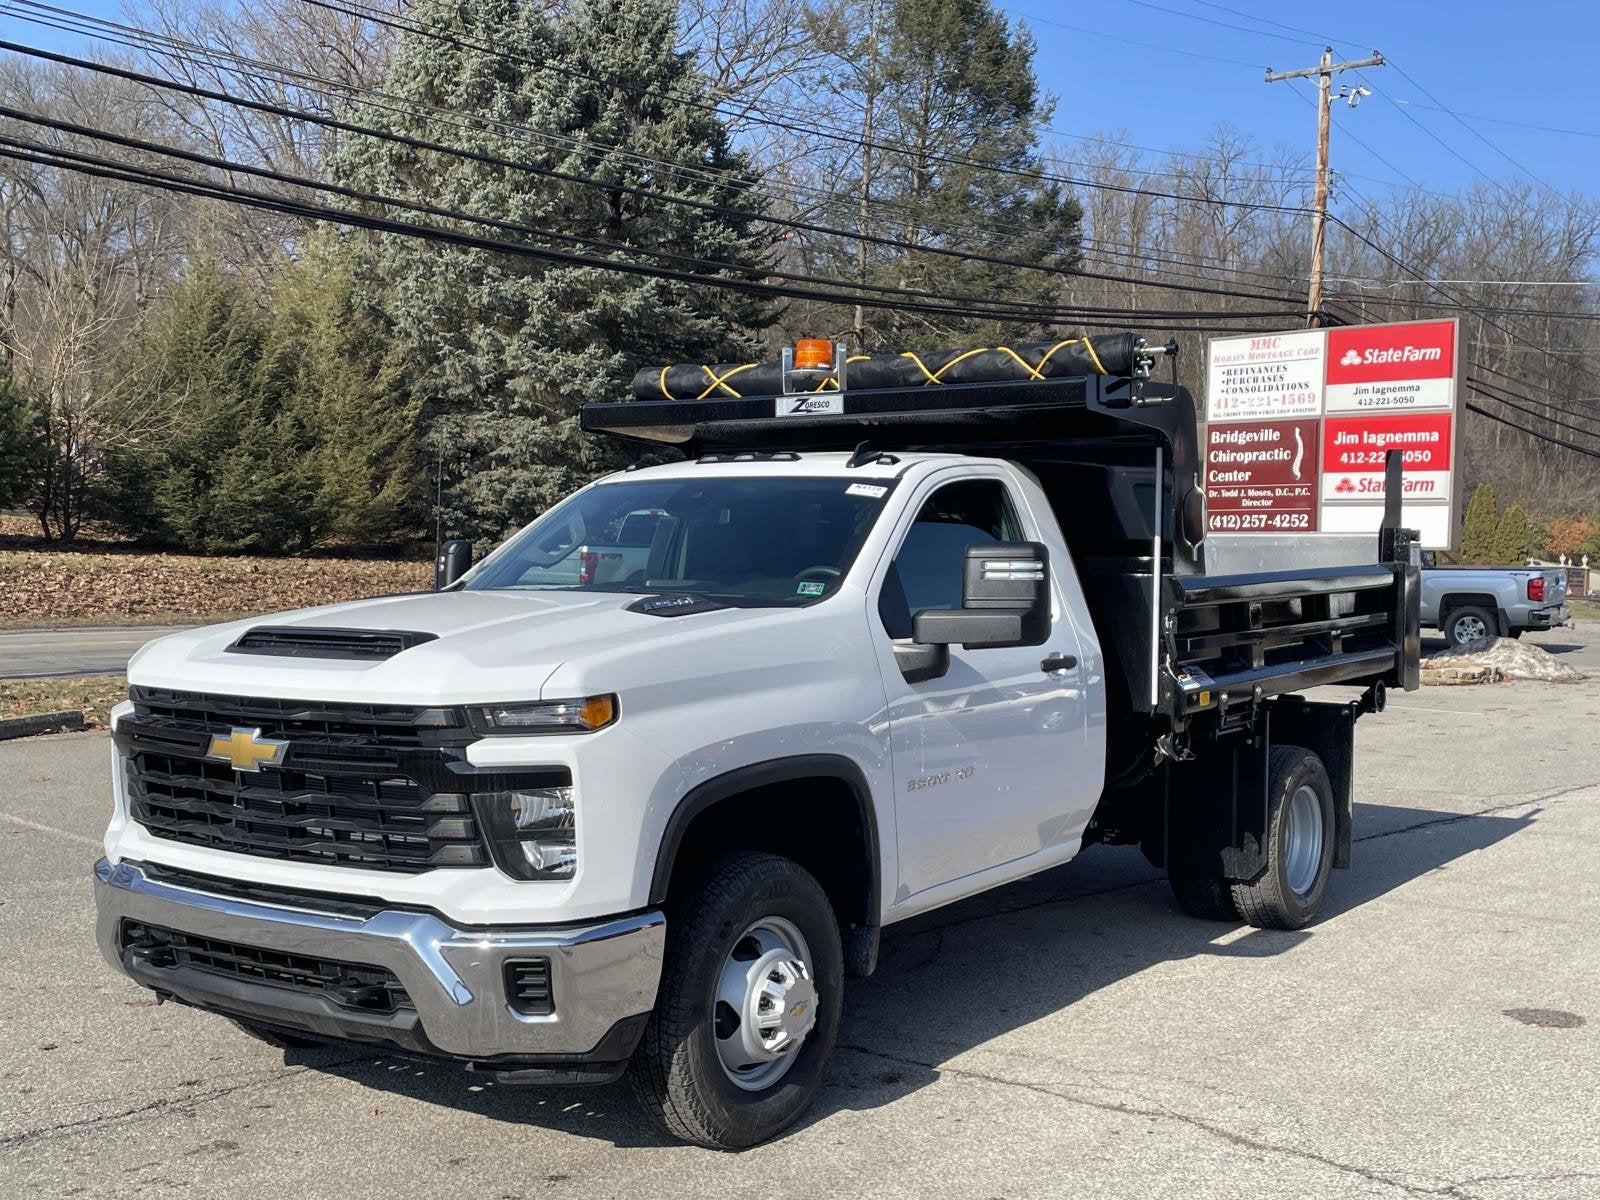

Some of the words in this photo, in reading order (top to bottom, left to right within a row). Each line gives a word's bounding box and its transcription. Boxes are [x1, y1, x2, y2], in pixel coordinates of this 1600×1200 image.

[1250, 337, 1281, 350] MMC
[1226, 364, 1288, 376] REFINANCES
[1226, 374, 1284, 385] PURCHASES
[1225, 381, 1310, 395] CONSOLIDATIONS
[1353, 386, 1369, 395] Jim
[1372, 384, 1420, 395] Iagnemma
[1357, 395, 1415, 406] 412-221-5050
[1211, 428, 1281, 445] Bridgeville
[1333, 431, 1359, 445] Jim
[1363, 430, 1439, 446] Iagnemma
[1210, 447, 1292, 464] Chiropractic
[1340, 449, 1432, 464] 412-22050
[1209, 470, 1252, 483] Center
[1209, 490, 1220, 498] Dr.
[1221, 489, 1238, 498] Todd
[1247, 488, 1274, 498] Moses,
[1295, 487, 1311, 496] P.C.
[1242, 498, 1273, 507] Director
